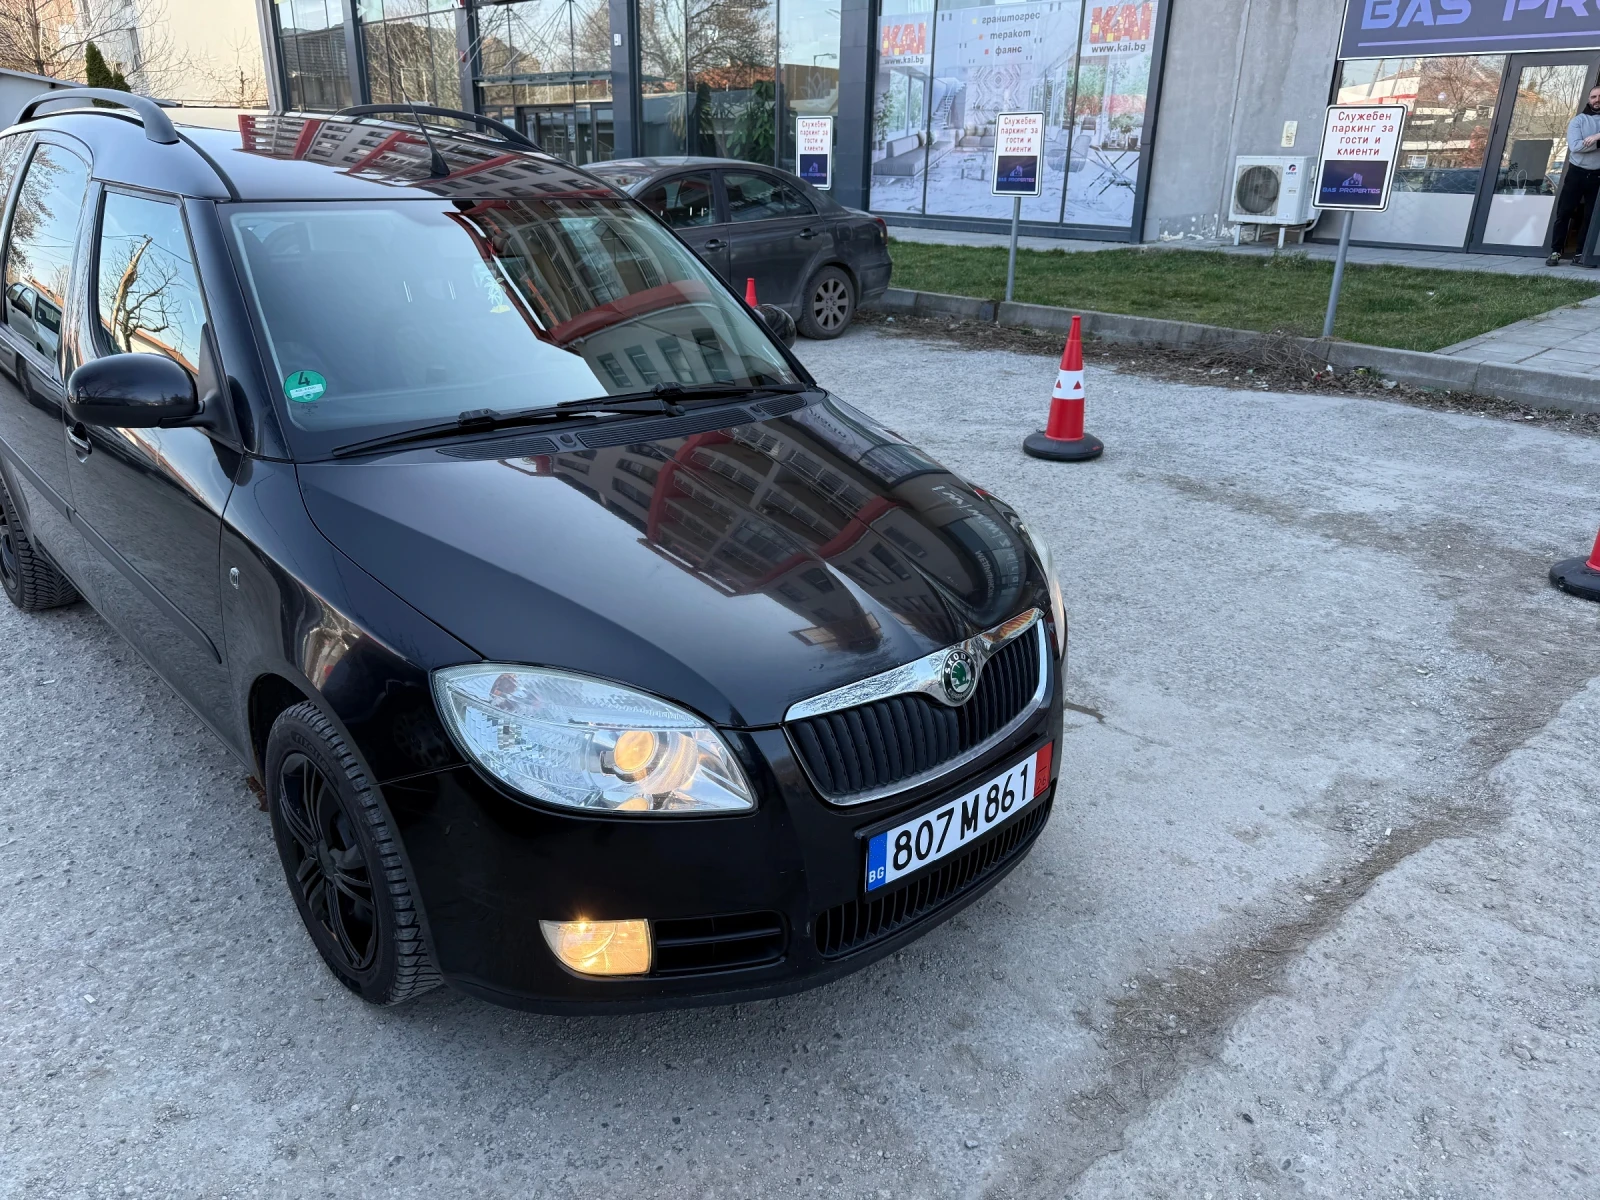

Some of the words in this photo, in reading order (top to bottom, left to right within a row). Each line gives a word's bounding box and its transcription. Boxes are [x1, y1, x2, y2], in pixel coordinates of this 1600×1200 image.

[982, 12, 1041, 25] гранитогрес
[1360, 0, 1471, 30] BAS
[1502, 0, 1600, 21] PR
[1089, 2, 1152, 44] KAI
[881, 22, 926, 56] KAI
[990, 29, 1031, 41] теракот
[995, 46, 1023, 56] фаянс
[1091, 42, 1146, 53] www.kai.bg
[884, 56, 924, 65] www.kai.bg
[1004, 117, 1037, 126] Служебен
[1338, 111, 1392, 123] Служебен
[1331, 125, 1376, 135] паркинг
[1340, 136, 1369, 144] гости
[1374, 136, 1381, 144] и
[297, 371, 311, 386] 4
[892, 807, 955, 871] 807
[959, 793, 980, 841] M
[984, 763, 1029, 824] 861
[868, 866, 885, 883] BG
